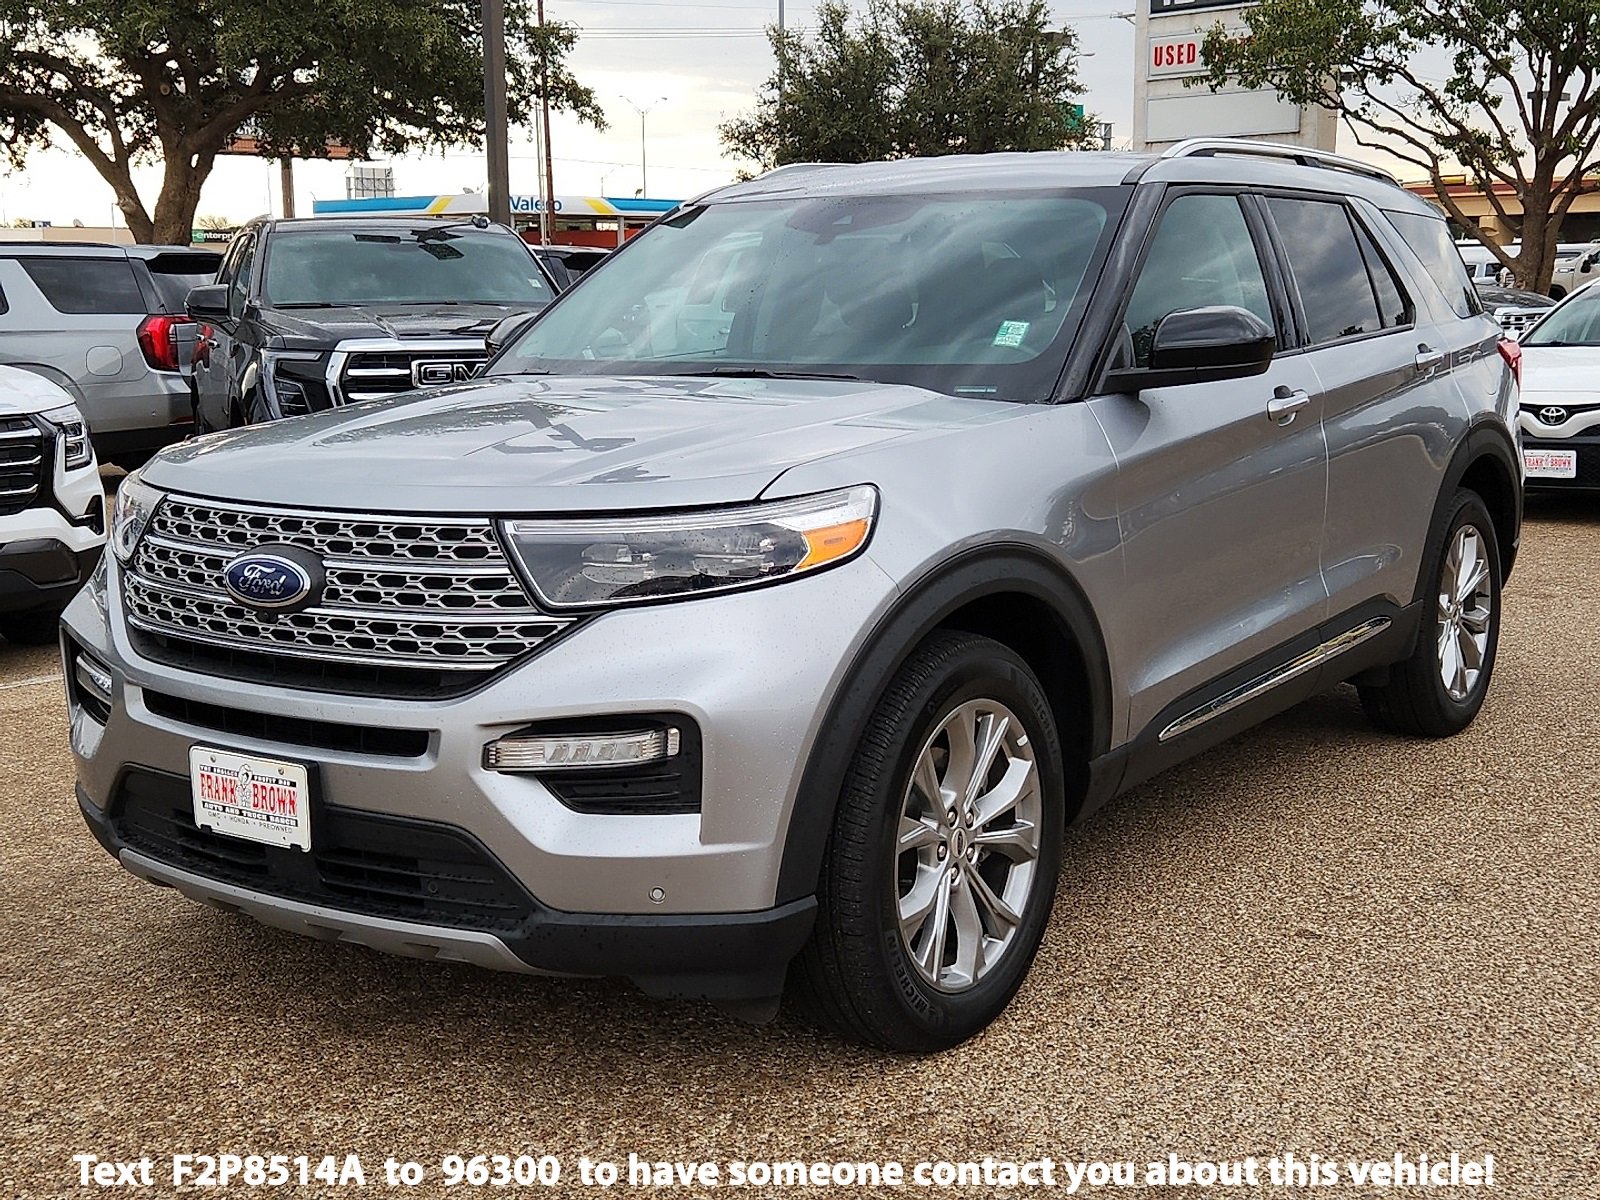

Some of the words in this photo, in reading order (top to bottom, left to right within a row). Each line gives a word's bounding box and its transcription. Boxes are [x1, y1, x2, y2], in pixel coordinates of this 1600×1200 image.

[1154, 43, 1196, 66] USED
[239, 564, 287, 595] Ford
[200, 773, 238, 805] FRANK
[252, 783, 297, 816] BROWN
[203, 802, 223, 812] AUTO
[225, 806, 240, 815] AND
[242, 810, 267, 821] TRUCK
[270, 814, 296, 827] RANCH
[259, 821, 293, 834] PREOWNED
